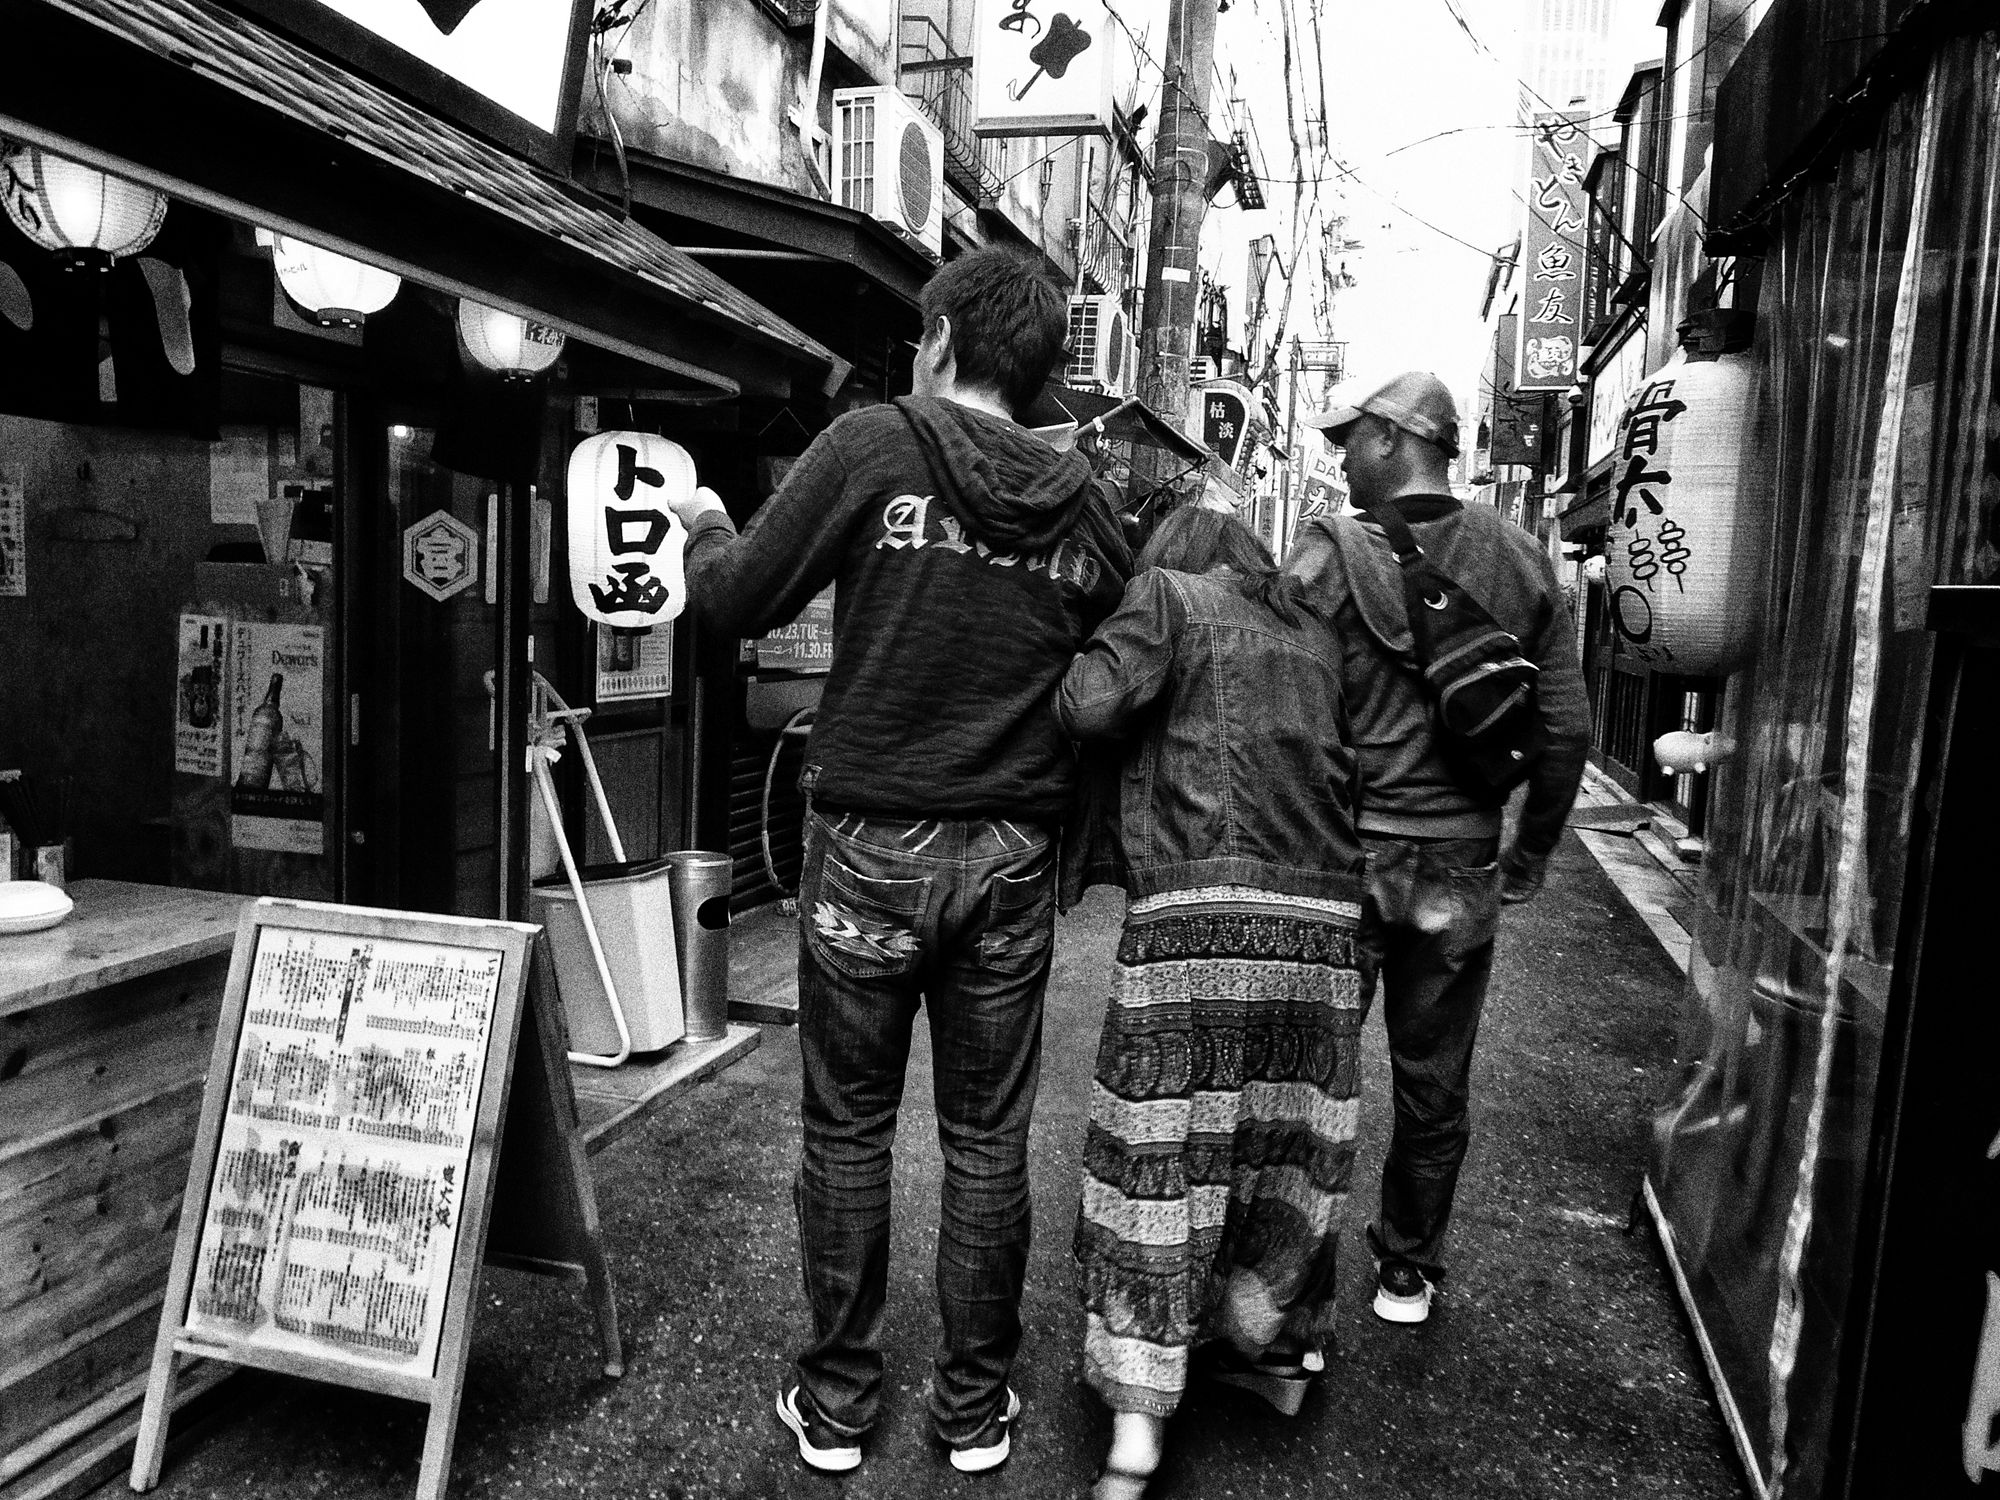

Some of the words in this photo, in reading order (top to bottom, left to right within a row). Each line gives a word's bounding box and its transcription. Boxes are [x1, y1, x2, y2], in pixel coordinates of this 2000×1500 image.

[1531, 114, 1585, 233] やきとん
[1529, 242, 1577, 324] 魚友
[1208, 400, 1235, 440] 枯淡
[1613, 379, 1687, 528] 骨太
[588, 443, 671, 615] トロ函
